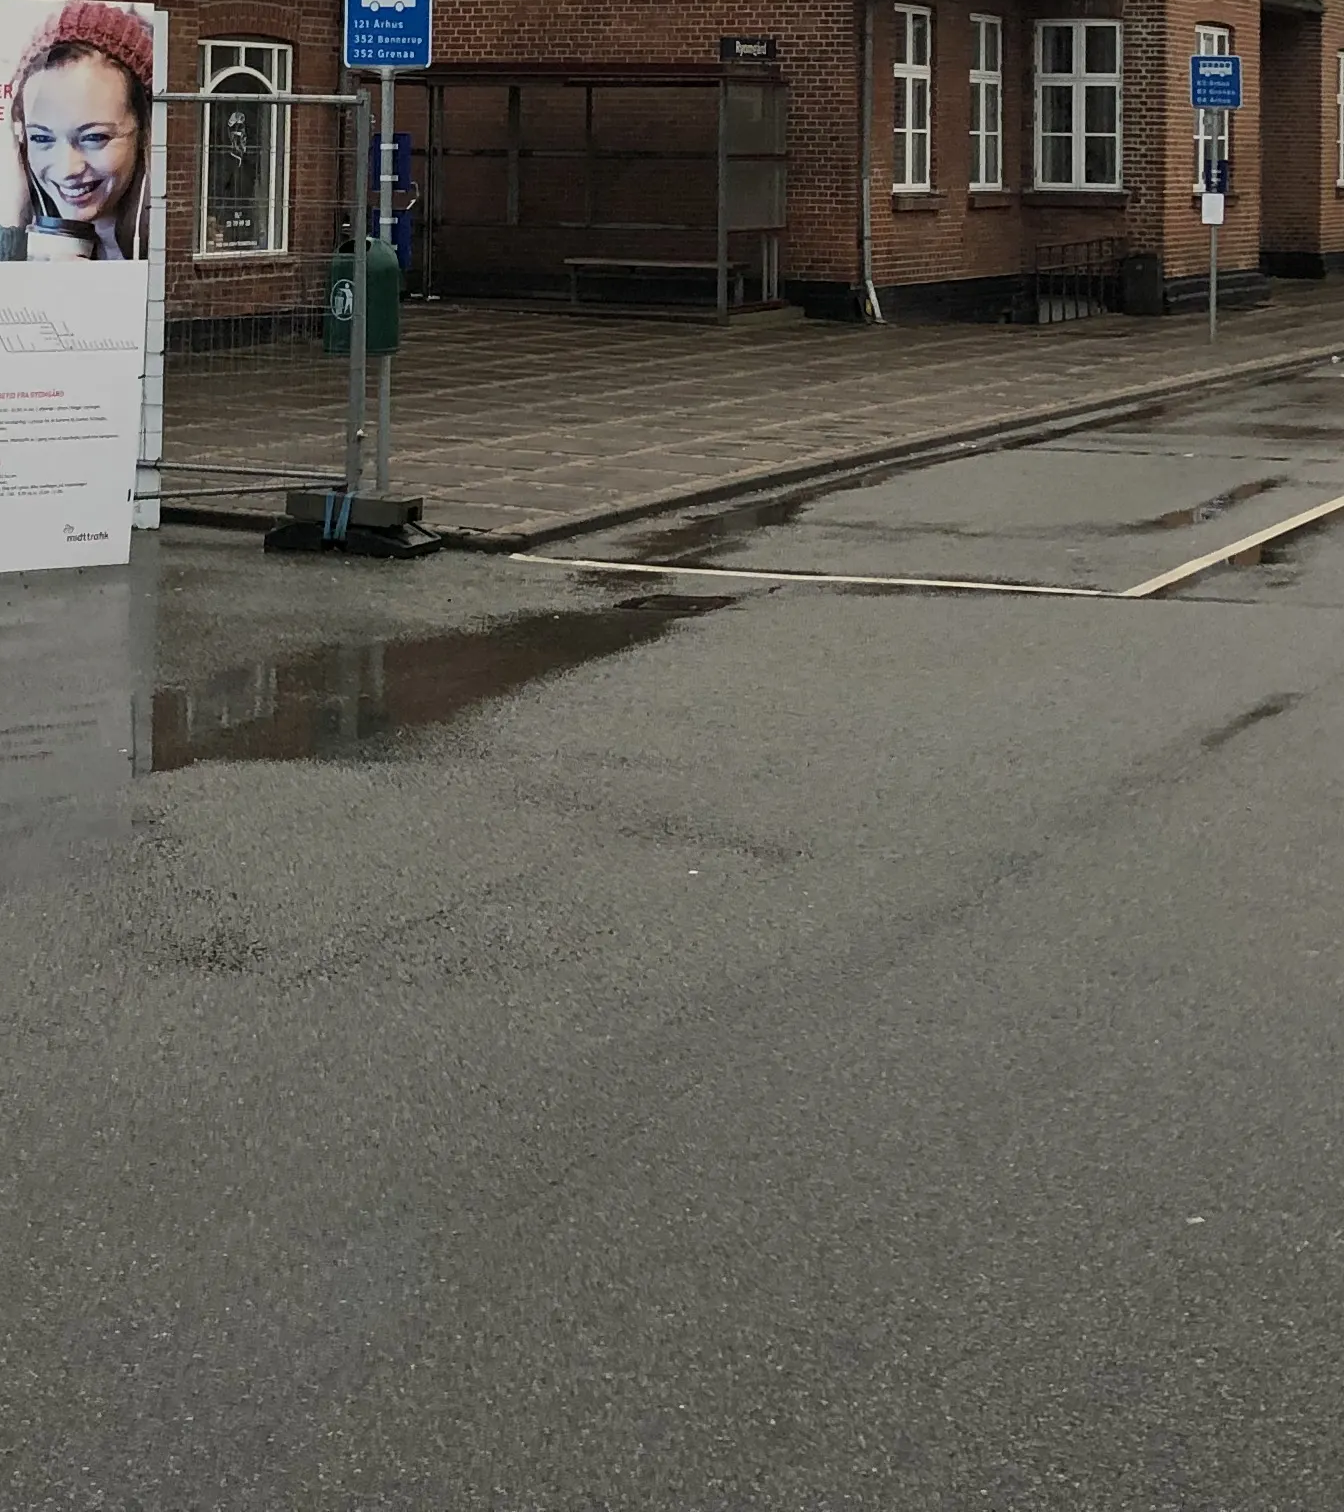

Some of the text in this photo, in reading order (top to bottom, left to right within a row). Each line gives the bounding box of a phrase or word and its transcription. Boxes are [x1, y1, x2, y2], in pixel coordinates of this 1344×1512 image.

[353, 19, 404, 29] 121 Århus
[354, 34, 374, 44] 352
[353, 49, 374, 58] 352
[17, 391, 30, 399] FRA
[66, 532, 109, 542] midttrafik
